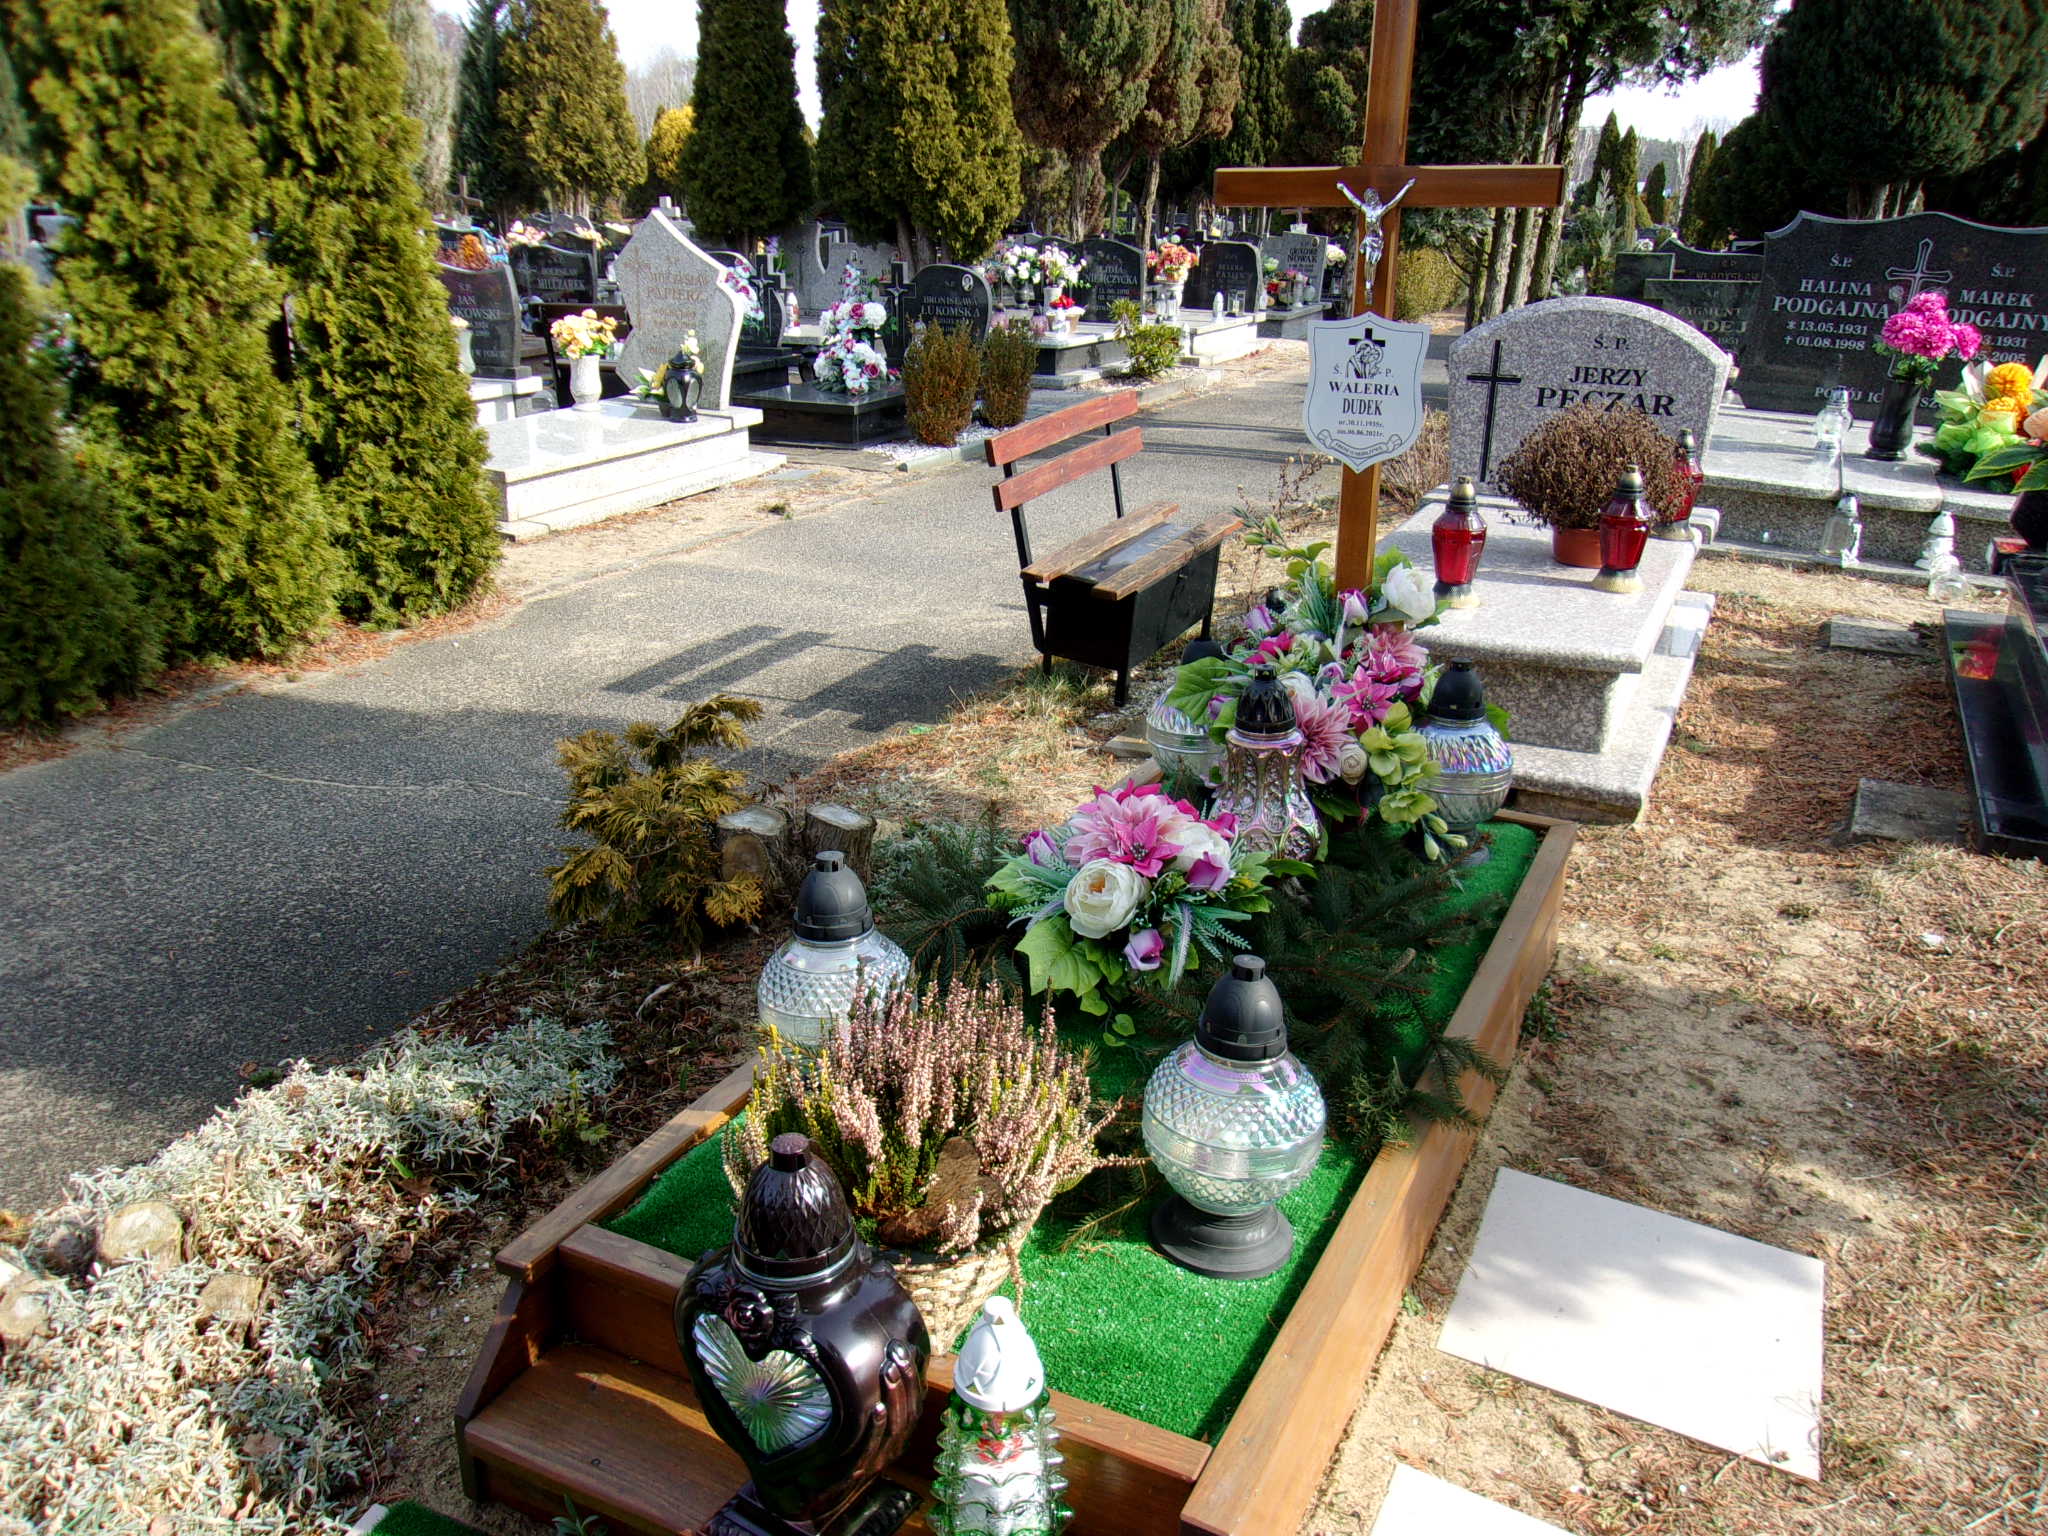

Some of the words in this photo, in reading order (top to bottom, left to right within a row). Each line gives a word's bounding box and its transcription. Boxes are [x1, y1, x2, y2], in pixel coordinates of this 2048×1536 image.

[1800, 279, 1872, 296] HALINA
[458, 295, 476, 305] JAN
[1960, 289, 2034, 307] MAREK
[1772, 296, 1889, 319] PODGAJNA
[1800, 321, 1867, 335] 13.05.1931
[1948, 309, 2047, 331] ODGAJNY
[1796, 336, 1866, 350] 01.08.1998
[1570, 366, 1649, 387] JERZY
[1329, 381, 1400, 396] WALERIA
[1342, 398, 1382, 416] DUDEK
